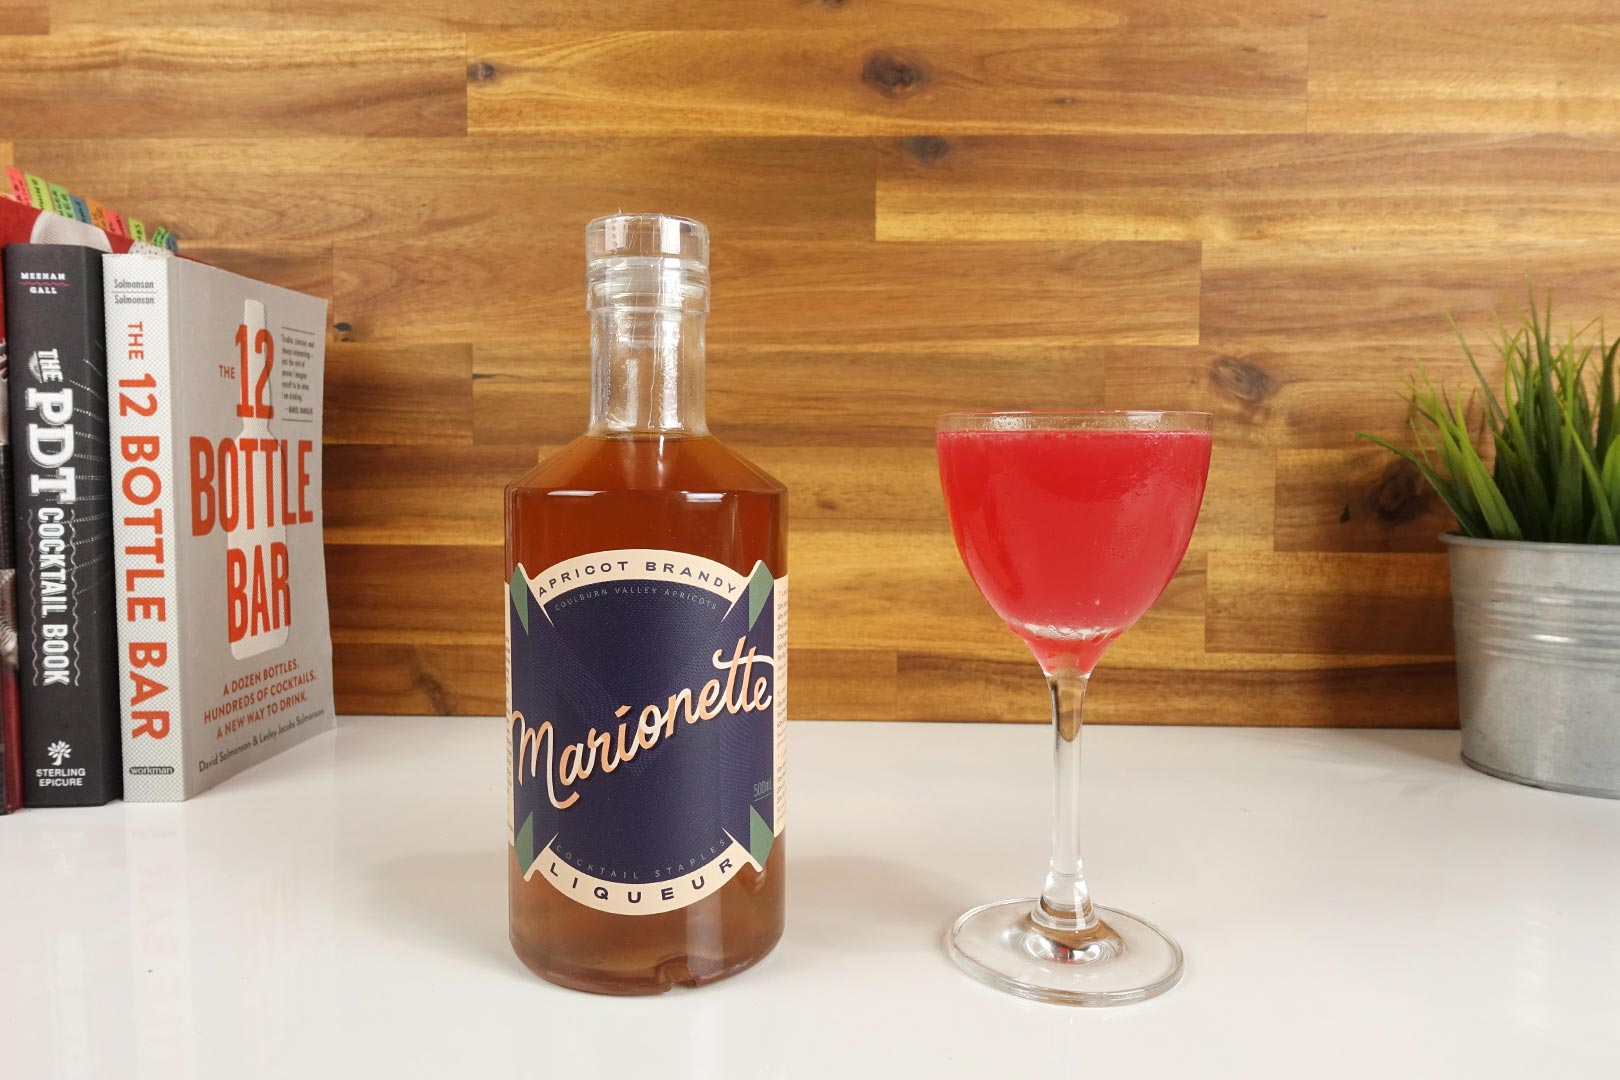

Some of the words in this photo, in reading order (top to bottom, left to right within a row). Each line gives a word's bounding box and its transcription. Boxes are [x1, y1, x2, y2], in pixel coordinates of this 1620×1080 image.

[20, 272, 66, 280] MEEHAN
[127, 321, 144, 360] THE
[37, 348, 64, 383] THE
[218, 365, 236, 380] THE
[235, 324, 274, 419] 12
[118, 373, 158, 417] 12
[26, 388, 77, 505] PDT
[189, 436, 314, 537] BOTTLE
[120, 436, 166, 622] BOTTLE
[37, 507, 68, 618] COCKTAIL
[538, 561, 629, 597] APRICOT
[645, 561, 737, 594] BRANDY
[227, 541, 292, 644] BAR
[554, 588, 608, 611] COULBURN
[614, 586, 657, 595] VALLEY
[664, 588, 717, 610] APRICOTS
[42, 624, 71, 687] BOOK
[128, 642, 171, 740] BAR
[204, 693, 255, 724] HUNDREDS
[256, 687, 269, 702] OF
[270, 670, 317, 696] COCKTAILS.
[223, 684, 229, 696] A
[231, 672, 261, 693] DOZEN
[216, 727, 223, 740] A
[224, 715, 245, 736] NEW
[246, 707, 265, 725] WAY
[266, 702, 279, 717] TO
[280, 690, 308, 712] DRINK.
[511, 635, 775, 810] Marionette
[199, 755, 219, 773] David
[252, 735, 259, 746] &
[259, 729, 278, 744] Lesley
[278, 719, 296, 735] Jacobs
[36, 768, 86, 777] STERLING
[39, 778, 83, 786] EPICURE
[131, 766, 173, 775] workman
[550, 858, 734, 904] LIQUEUR
[556, 844, 639, 880] COCKTAIL
[655, 839, 726, 878] STAPLES
